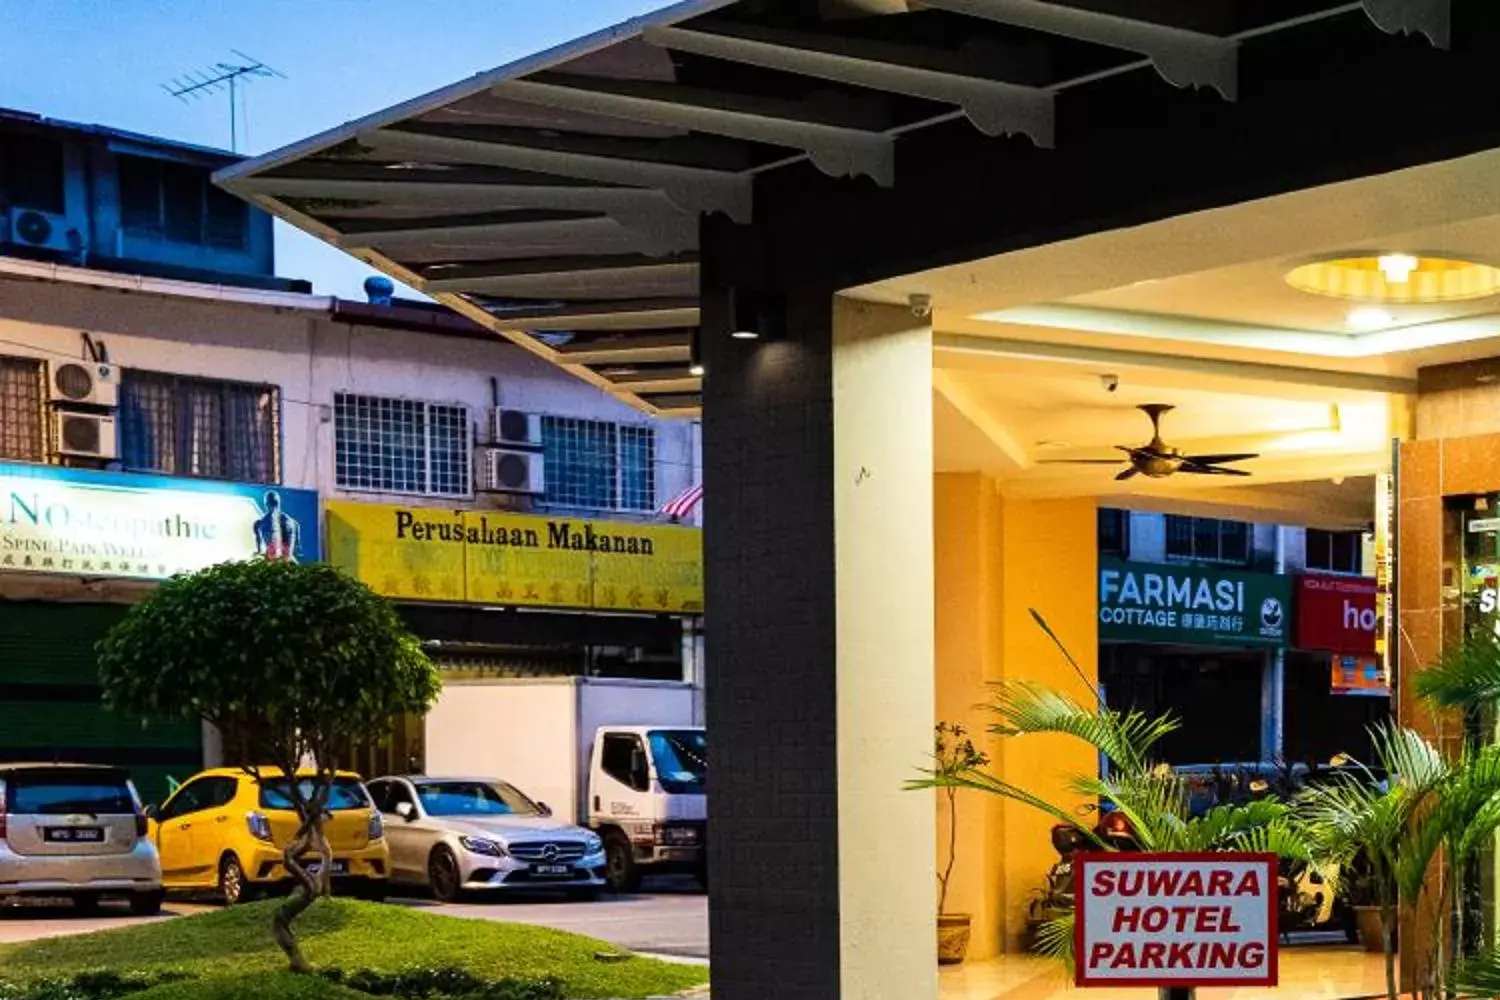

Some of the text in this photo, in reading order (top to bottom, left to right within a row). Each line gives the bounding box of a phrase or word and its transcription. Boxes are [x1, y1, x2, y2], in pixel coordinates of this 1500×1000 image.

[395, 510, 654, 556] Perusahaan Makanan
[1101, 568, 1245, 613] FARMASI
[1100, 607, 1177, 628] COTTAGE
[1091, 869, 1261, 897] SUWARA
[1111, 906, 1242, 933] HOTEL
[1089, 942, 1265, 969] PARKING
